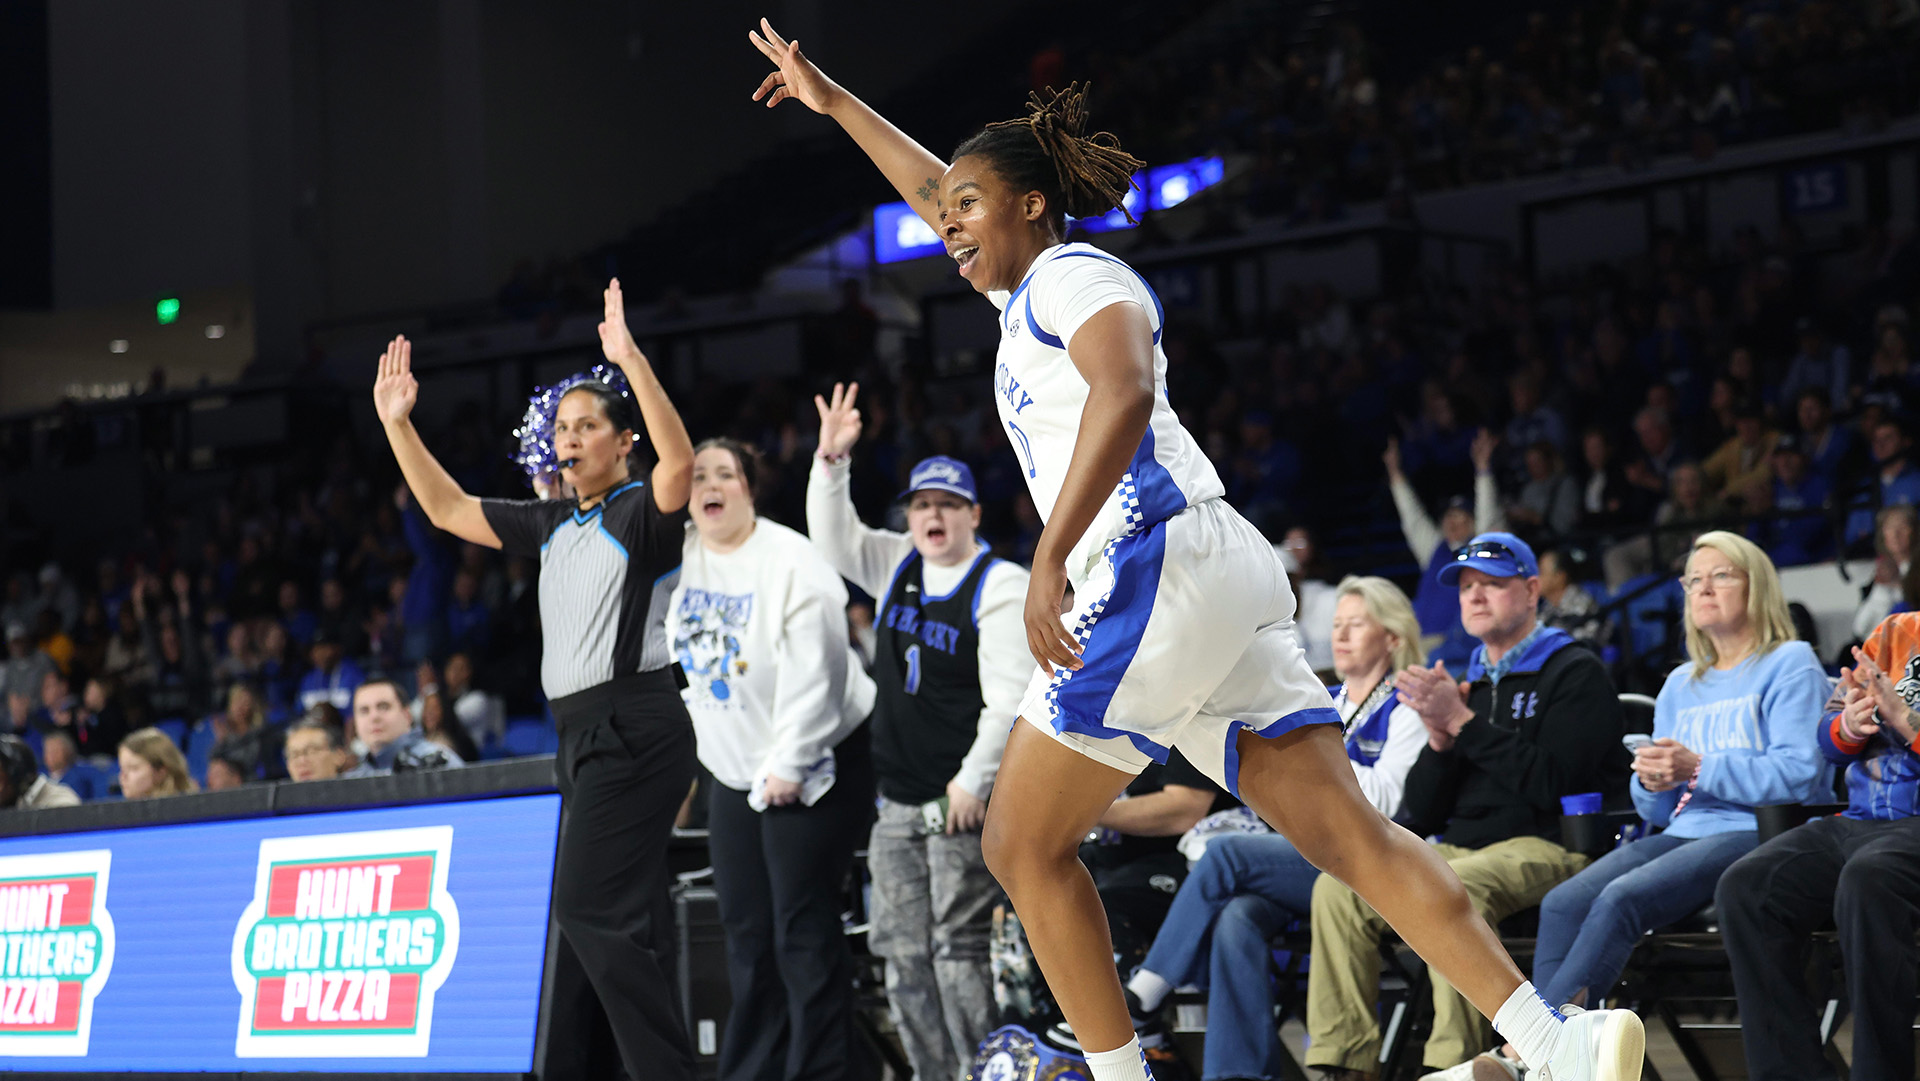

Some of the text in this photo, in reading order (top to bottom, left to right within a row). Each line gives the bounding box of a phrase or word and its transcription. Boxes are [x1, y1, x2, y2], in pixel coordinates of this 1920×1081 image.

[886, 602, 960, 656] KENCKY
[904, 643, 922, 696] 1
[294, 864, 401, 921] HUNT
[251, 916, 437, 971] BROTHERS
[280, 968, 391, 1022] PIZZA
